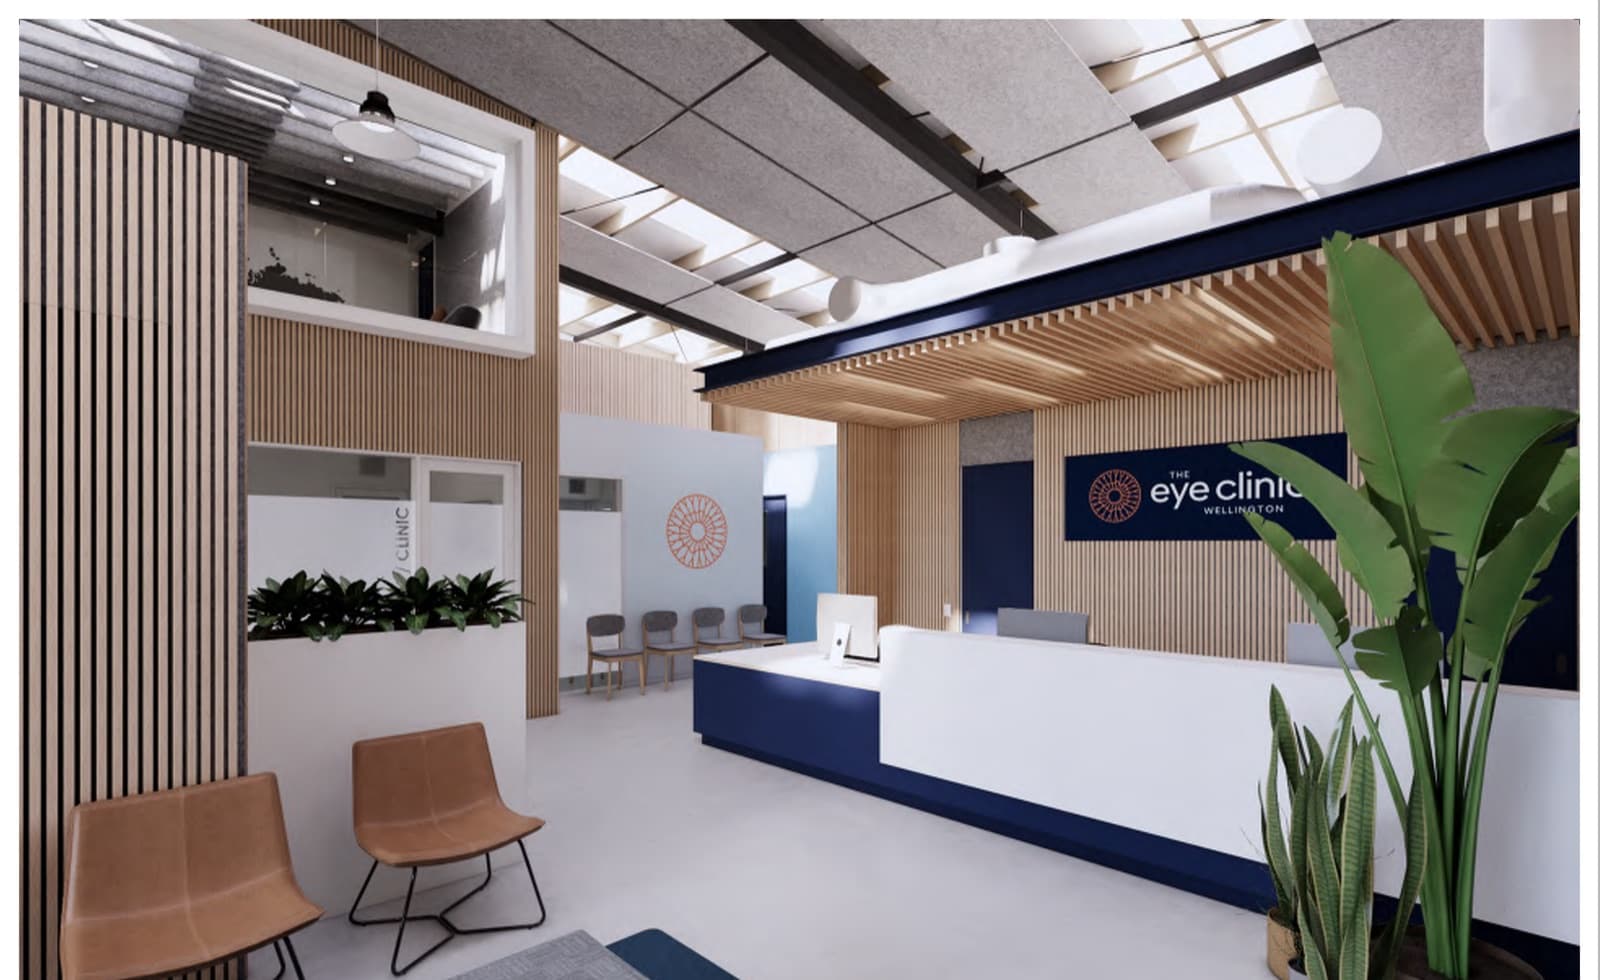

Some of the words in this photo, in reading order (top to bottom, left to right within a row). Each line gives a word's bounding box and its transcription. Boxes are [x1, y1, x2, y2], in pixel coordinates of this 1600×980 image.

[1170, 470, 1190, 479] THE
[1150, 481, 1210, 510] eye
[1215, 470, 1304, 501] clinic
[1204, 504, 1284, 515] WELLINGTON
[395, 506, 410, 561] CLINIC
